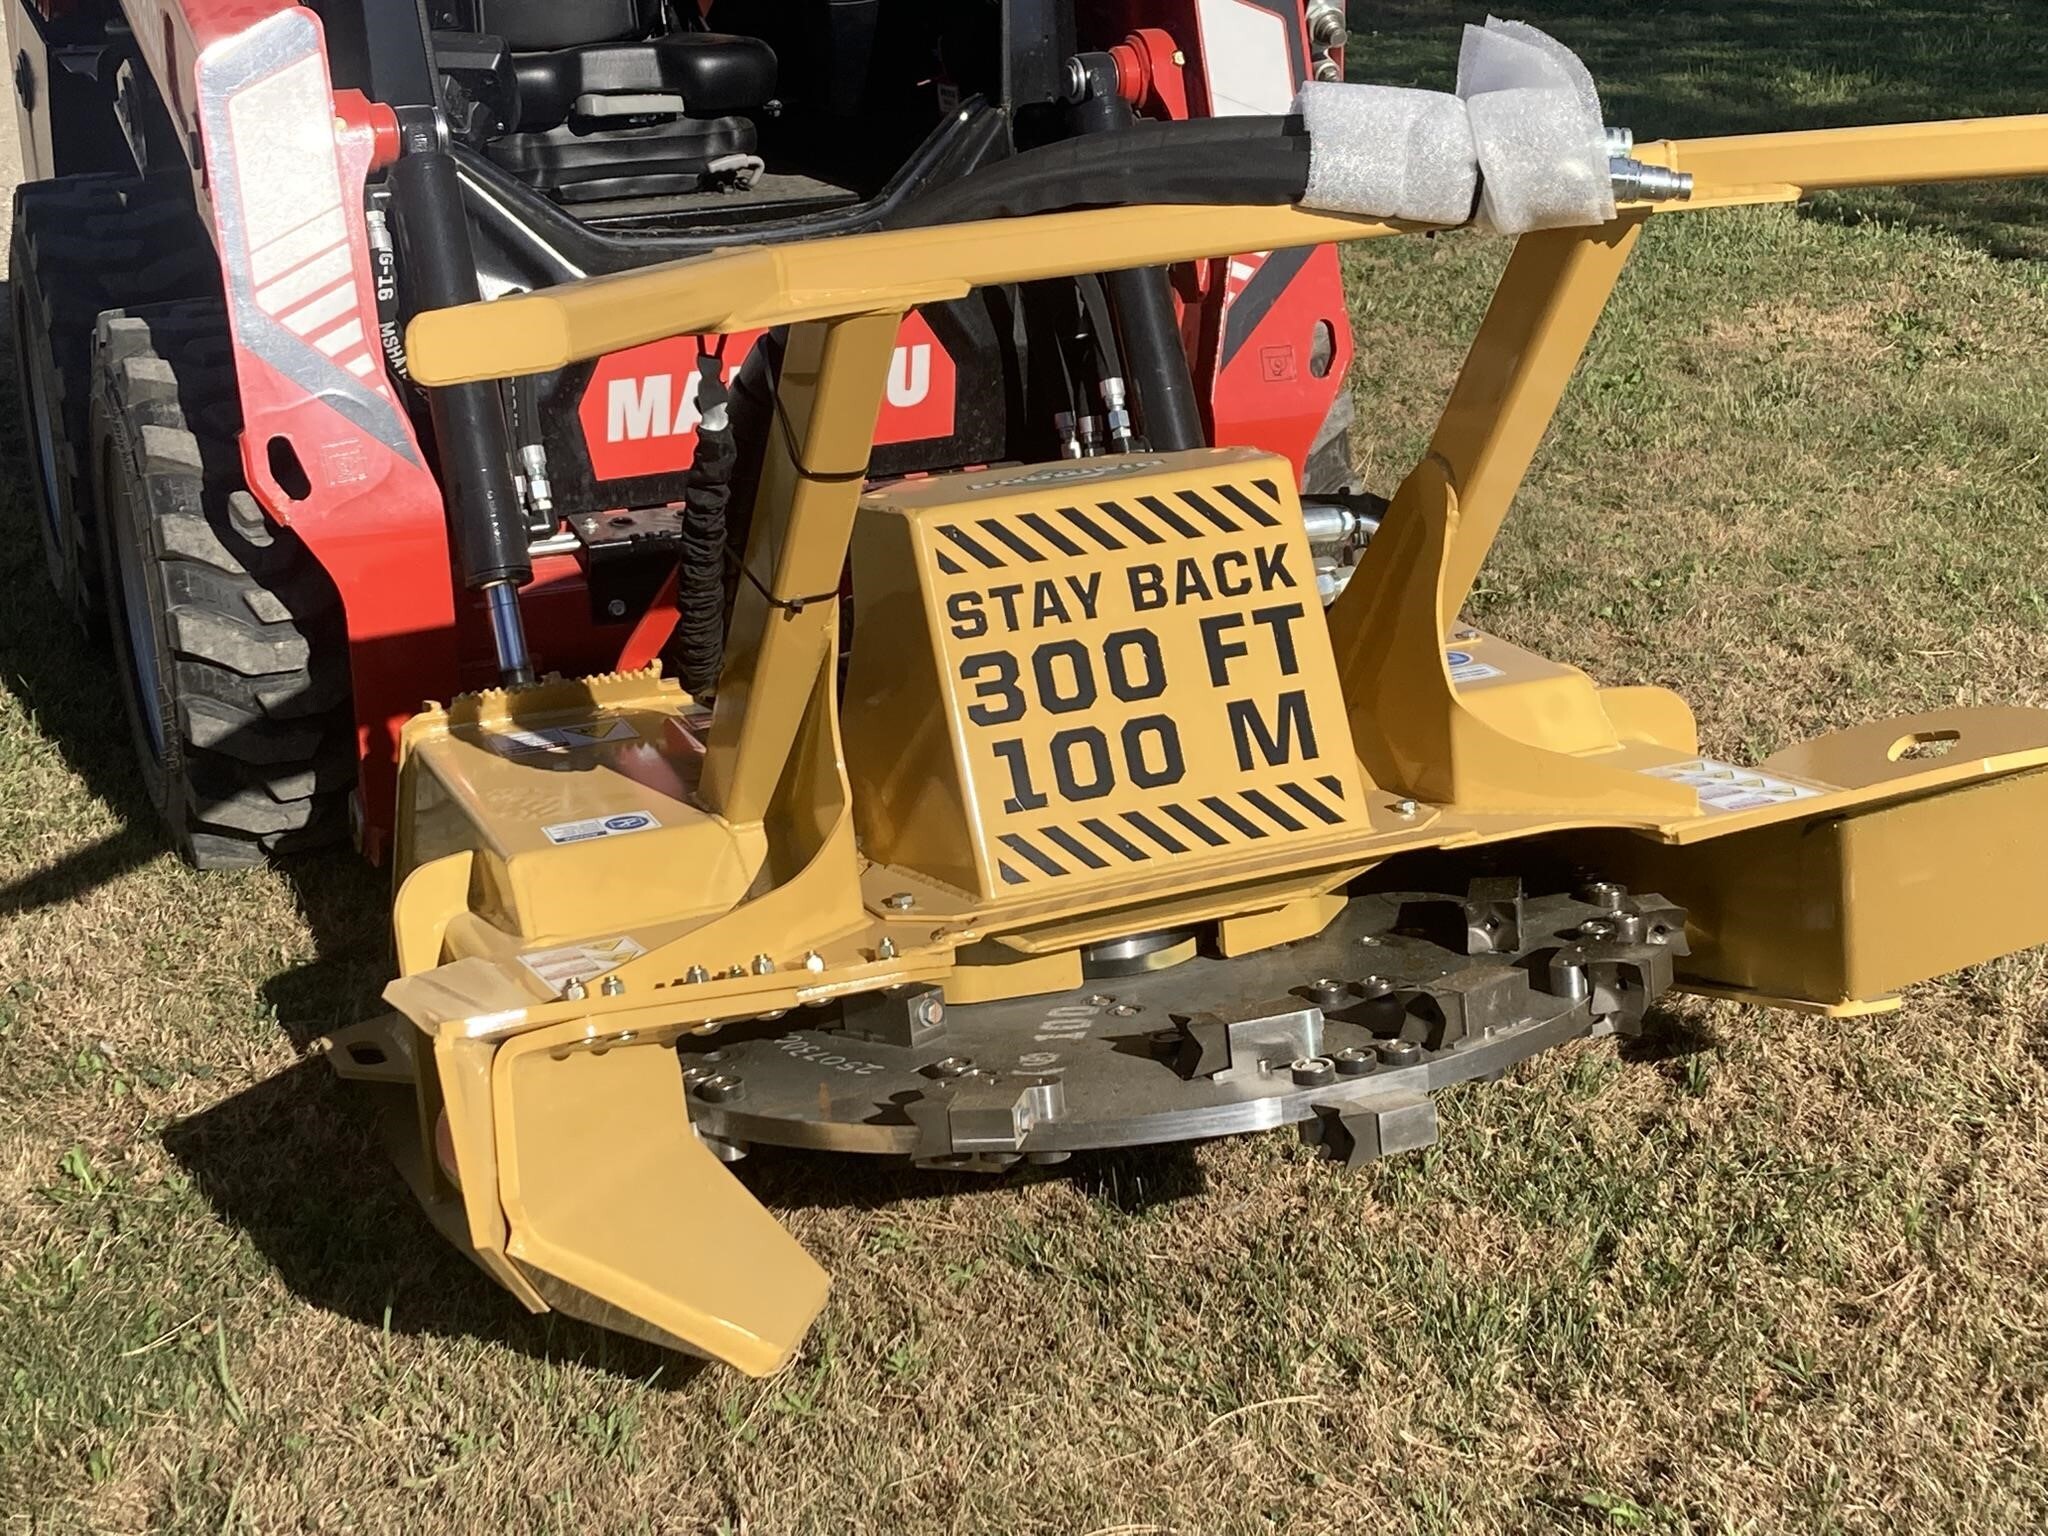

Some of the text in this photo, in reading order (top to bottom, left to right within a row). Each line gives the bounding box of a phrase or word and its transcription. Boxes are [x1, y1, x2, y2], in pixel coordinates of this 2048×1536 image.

[380, 321, 408, 369] MSHA
[946, 543, 1298, 640] STAY BACK
[959, 602, 1305, 727] 300 FT
[992, 689, 1320, 815] 100 M
